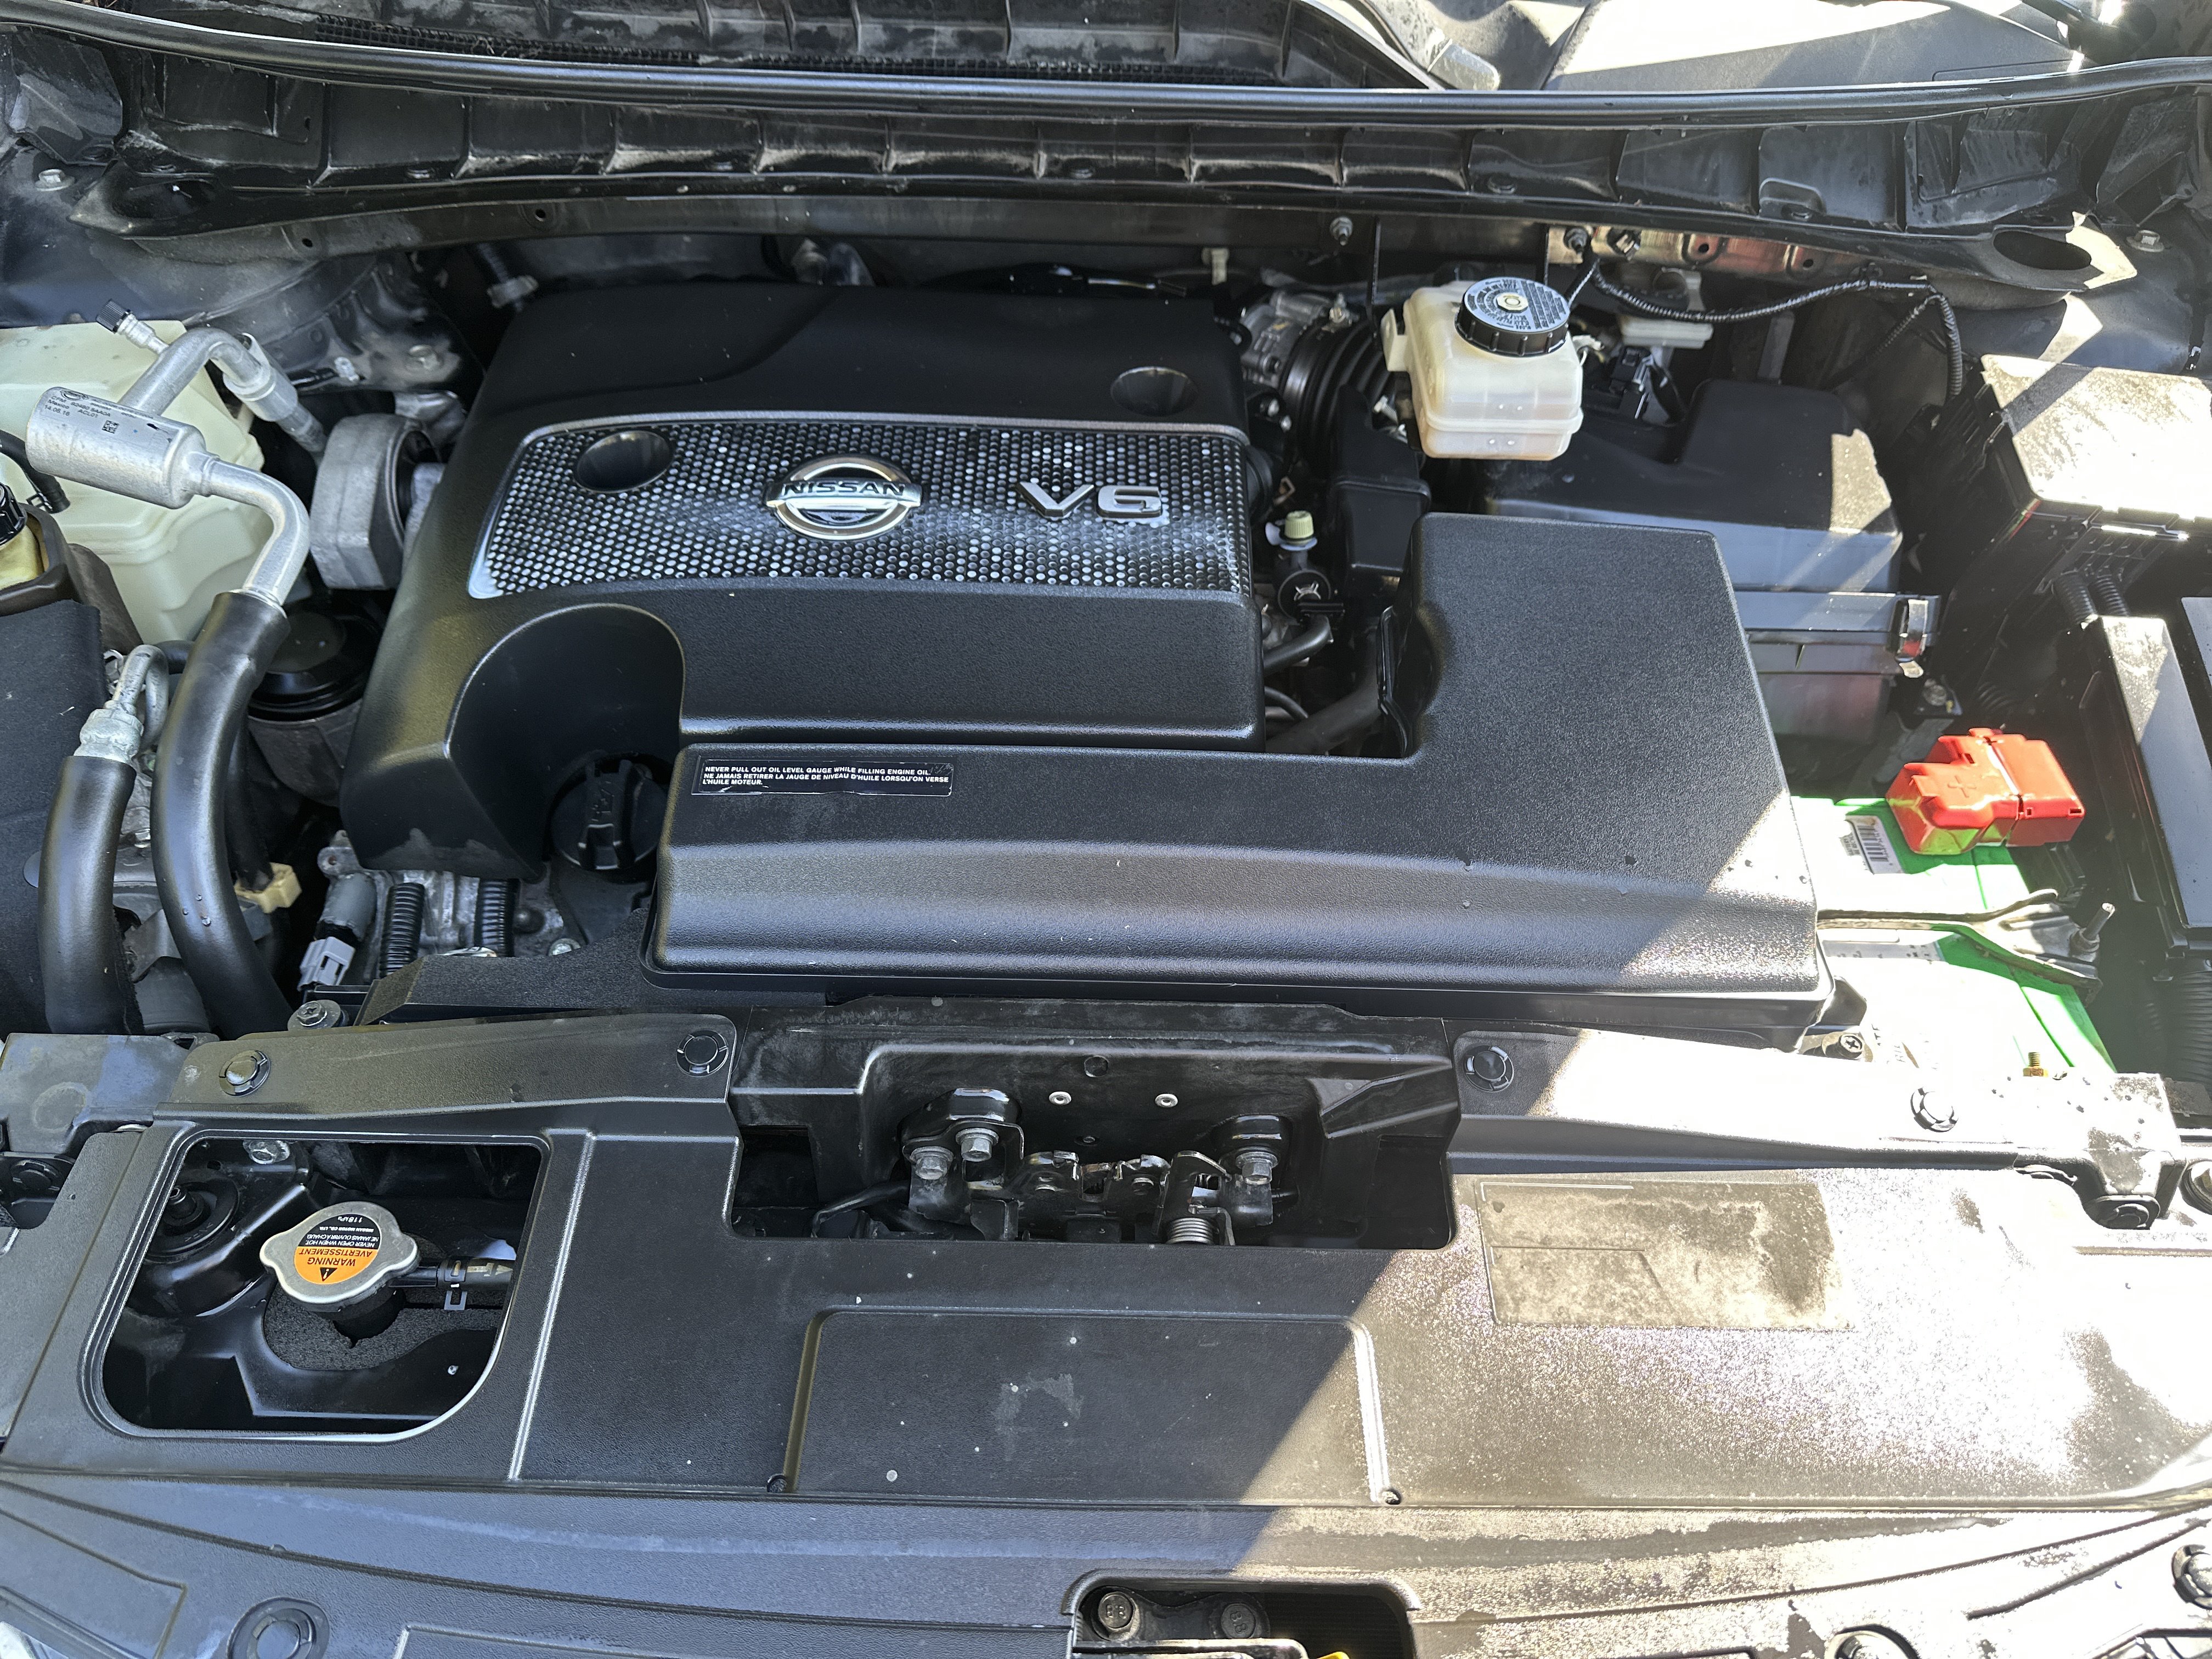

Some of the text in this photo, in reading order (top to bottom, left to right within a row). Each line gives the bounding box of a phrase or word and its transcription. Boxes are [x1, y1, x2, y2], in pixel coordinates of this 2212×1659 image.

[47, 399, 70, 409] Mexico
[781, 481, 905, 496] NISSAN
[1016, 481, 1162, 519] V6
[298, 1248, 373, 1257] AVERTISSEMENT
[307, 1257, 356, 1266] WARNING
